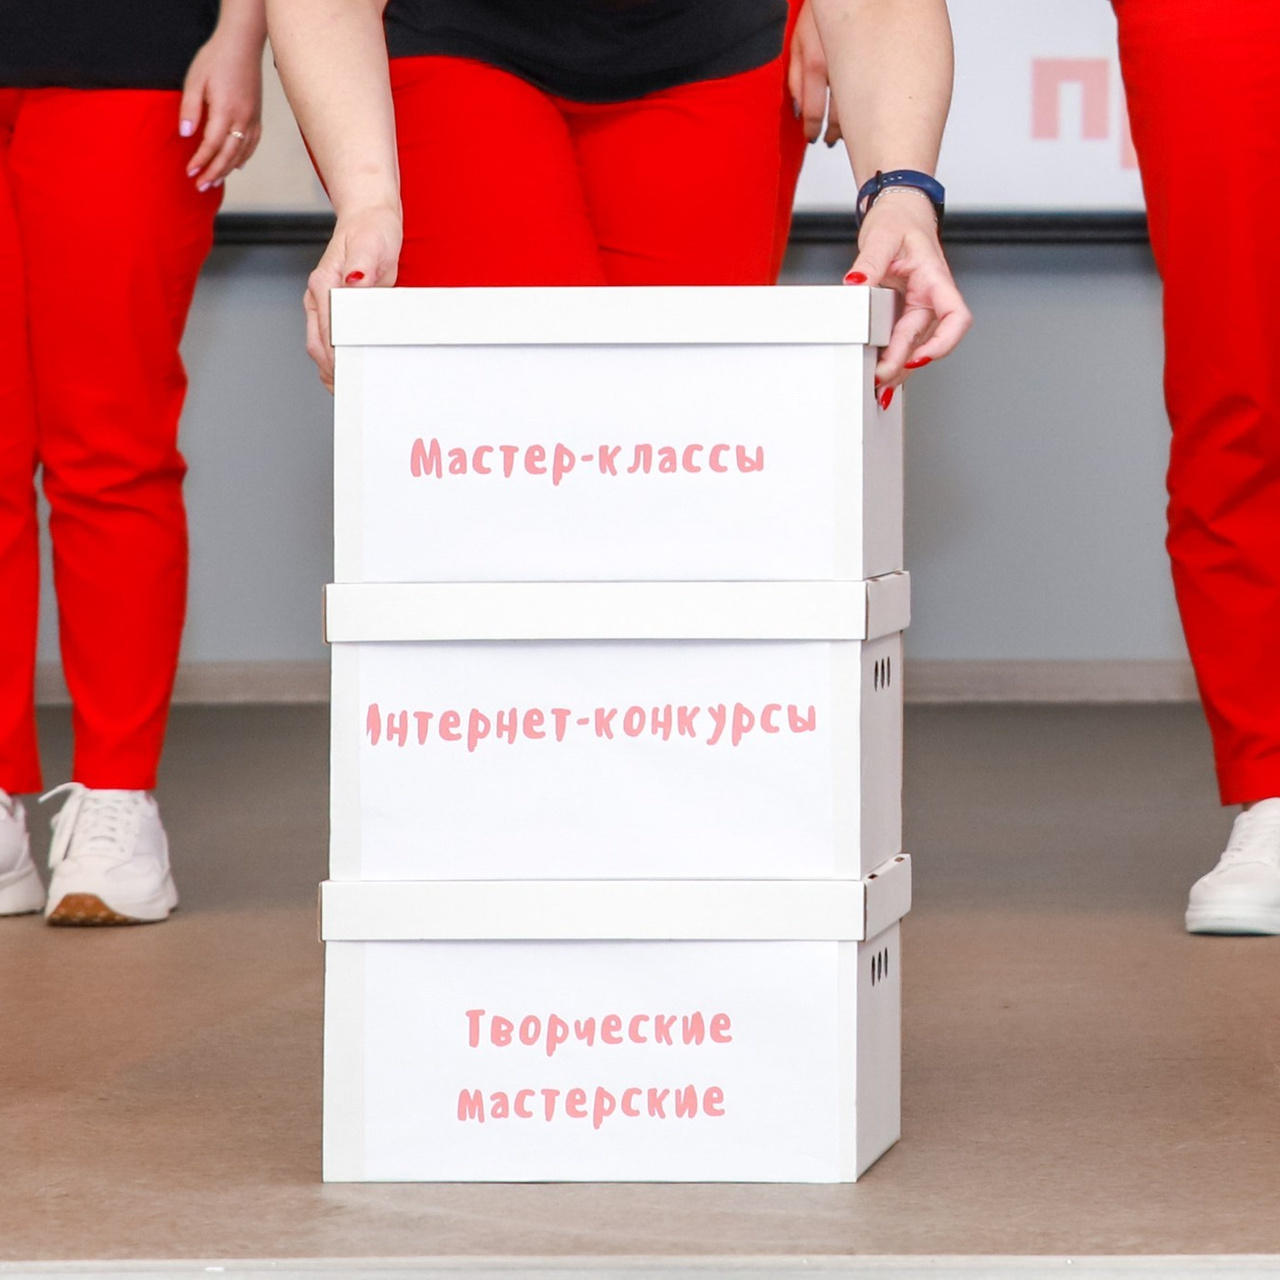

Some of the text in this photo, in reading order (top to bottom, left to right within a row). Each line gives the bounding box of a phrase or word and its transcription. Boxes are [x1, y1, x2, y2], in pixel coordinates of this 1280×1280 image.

[409, 437, 765, 487] Мастер-классы
[465, 1008, 733, 1057] Творческие
[457, 1084, 726, 1131] мастерские
